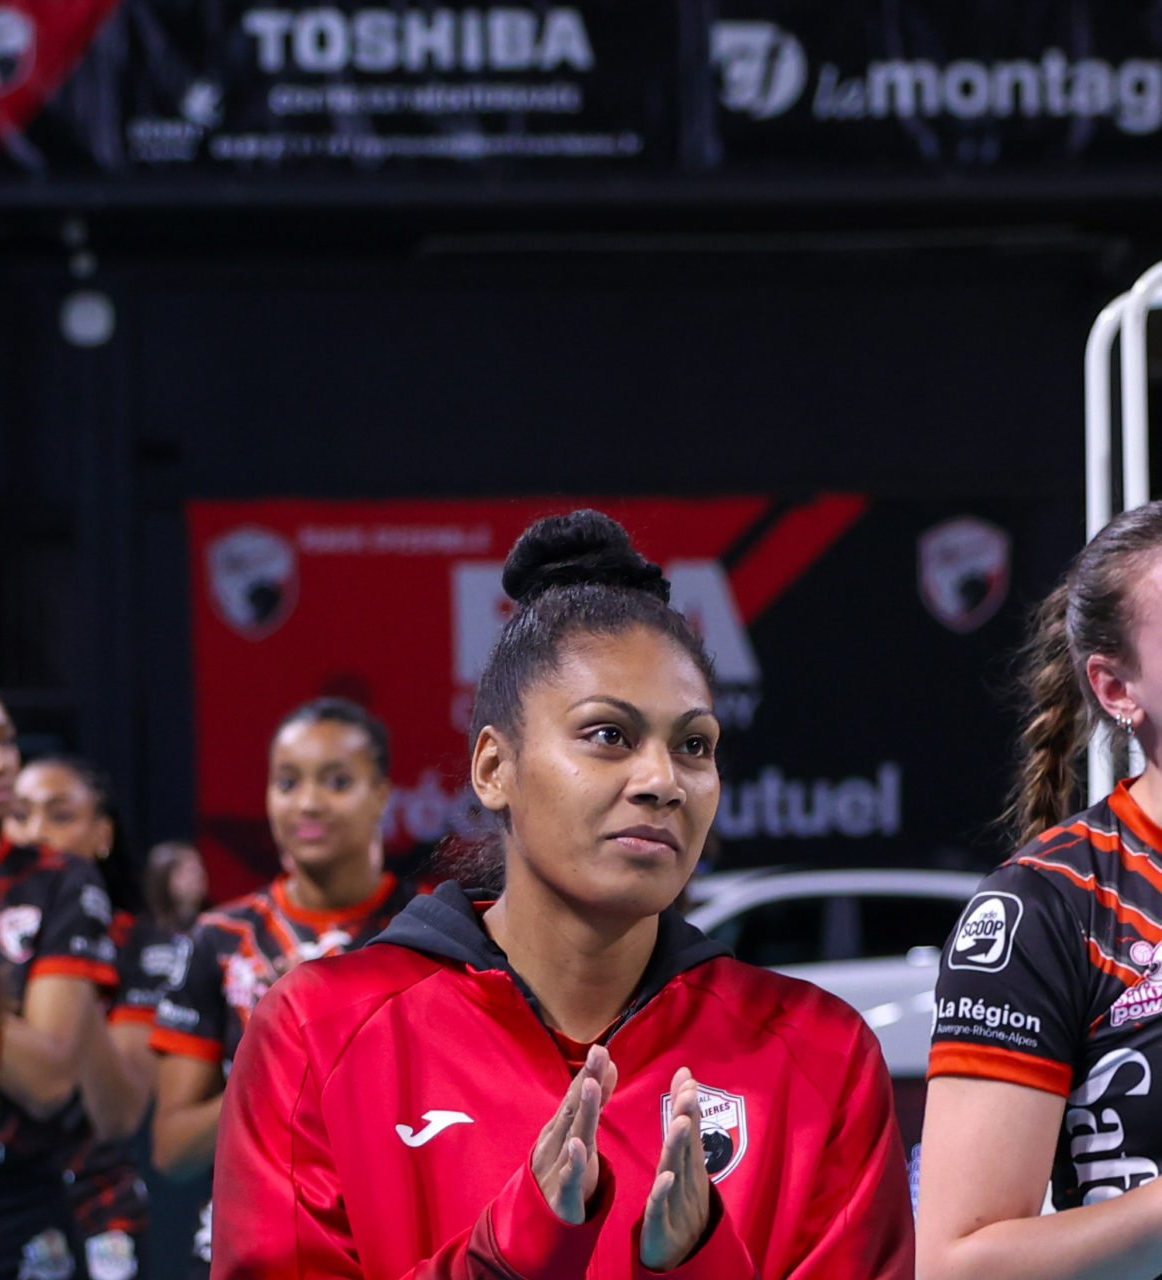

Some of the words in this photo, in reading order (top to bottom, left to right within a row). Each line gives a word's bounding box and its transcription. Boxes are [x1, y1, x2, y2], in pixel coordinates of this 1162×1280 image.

[243, 8, 593, 72] TOSHIBA
[961, 920, 1005, 939] SCOOP
[938, 998, 955, 1018] La
[958, 997, 1041, 1033] Région
